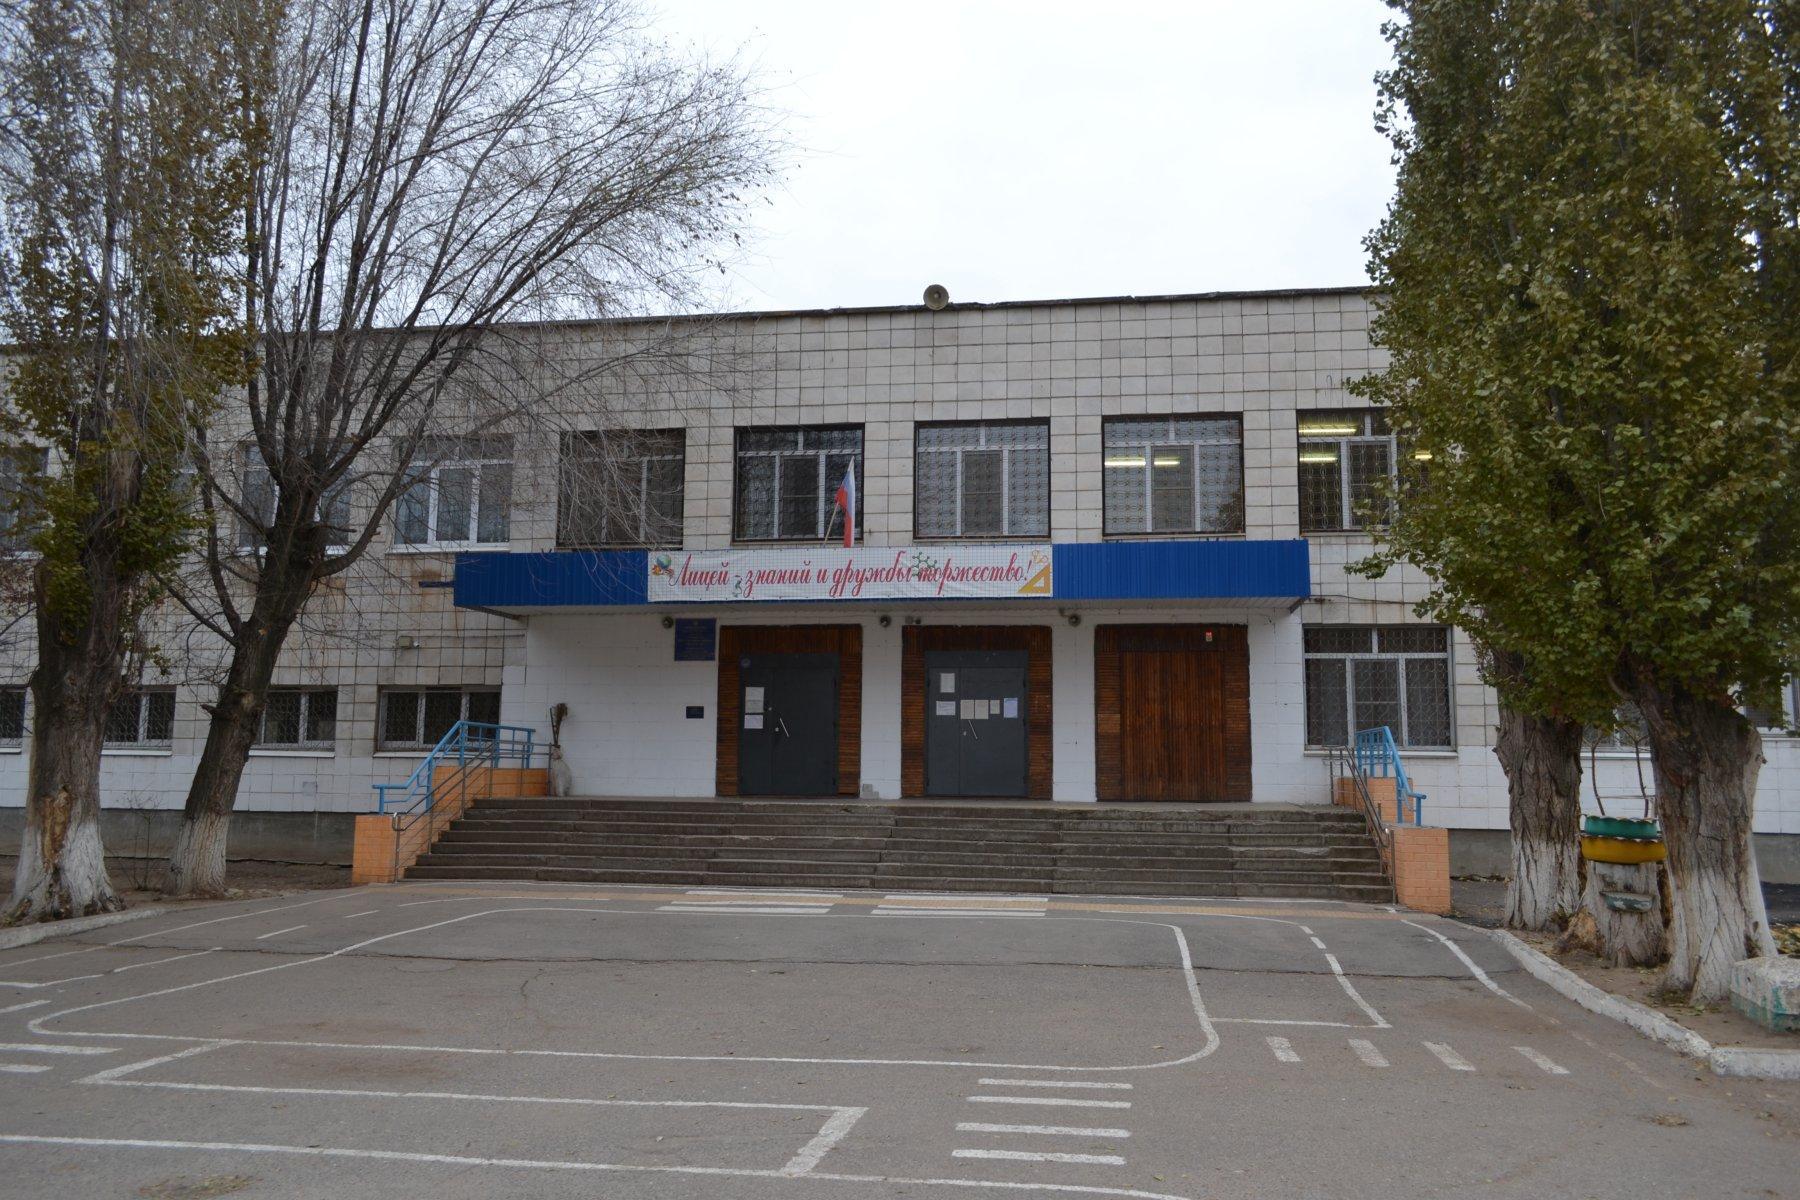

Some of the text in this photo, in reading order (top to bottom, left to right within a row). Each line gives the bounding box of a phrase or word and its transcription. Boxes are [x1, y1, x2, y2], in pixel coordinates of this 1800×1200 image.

[668, 553, 730, 591] Лицей
[743, 560, 812, 598] знаний
[816, 568, 829, 583] и
[829, 550, 912, 597] дружбы
[917, 552, 1032, 596] торжество!
